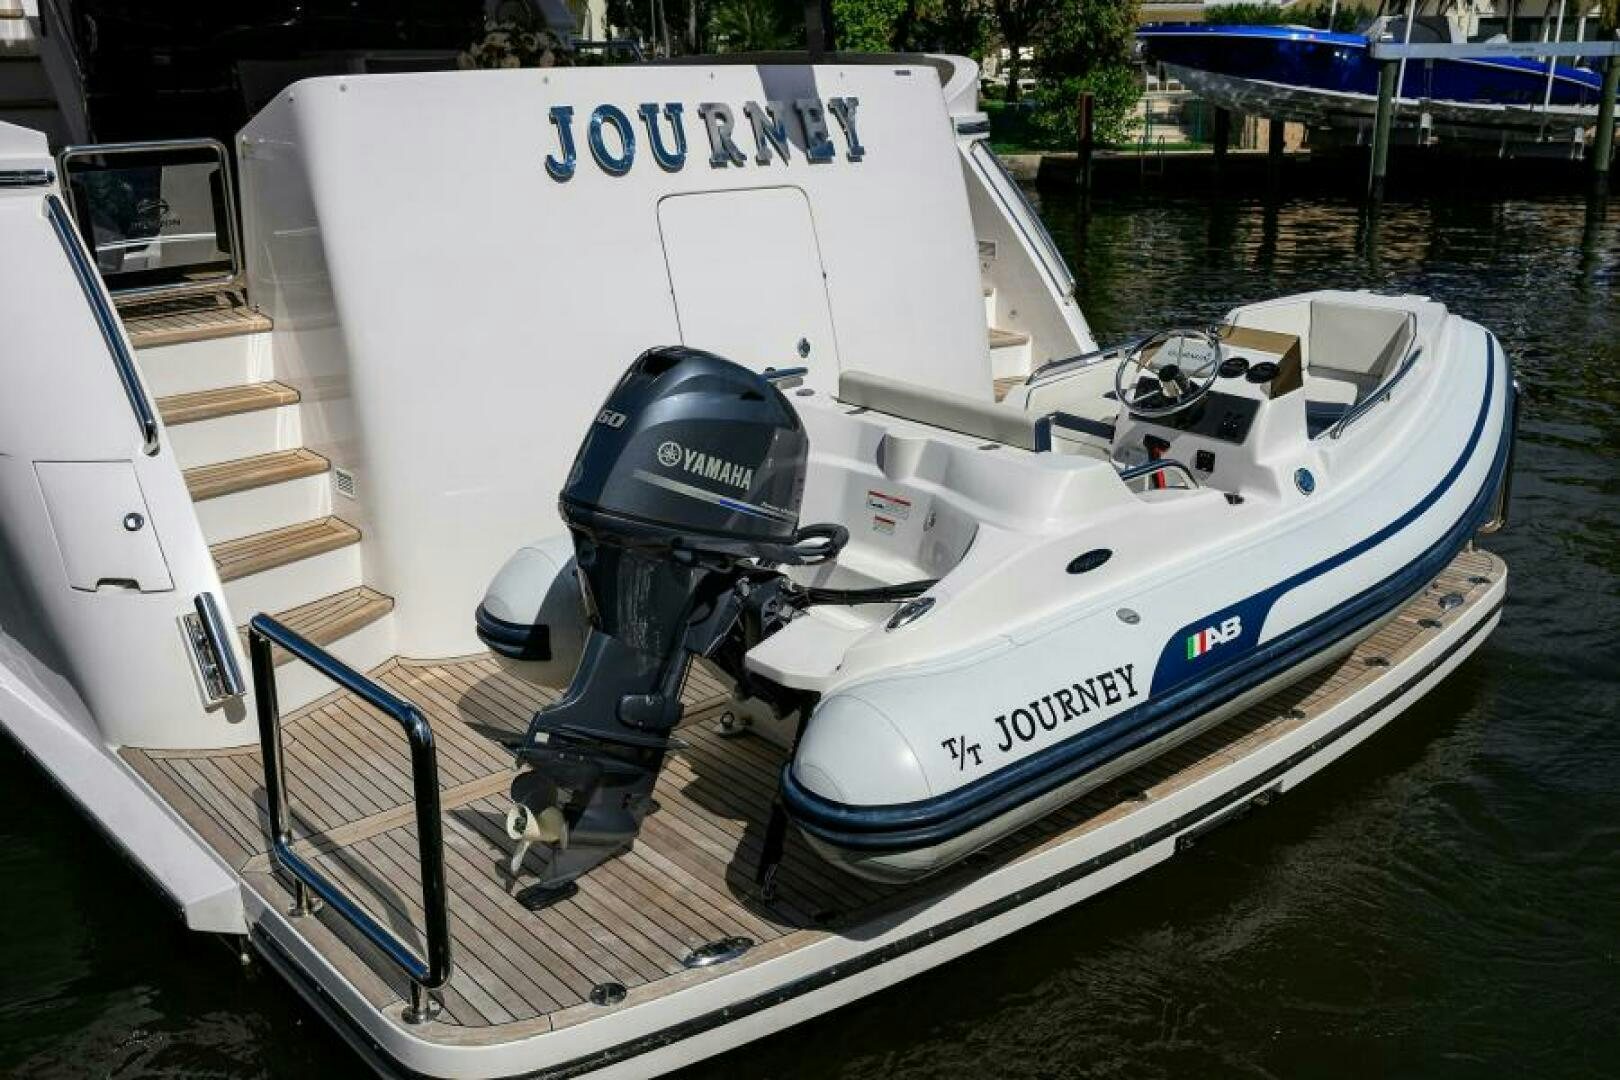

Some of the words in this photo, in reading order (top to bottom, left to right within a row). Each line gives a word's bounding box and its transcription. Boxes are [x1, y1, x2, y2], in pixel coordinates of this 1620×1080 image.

[544, 97, 865, 183] JOURNEY
[683, 447, 754, 491] YAMAHA
[1205, 615, 1243, 652] AB
[941, 735, 982, 771] T/T
[994, 663, 1139, 752] JOURNEY
